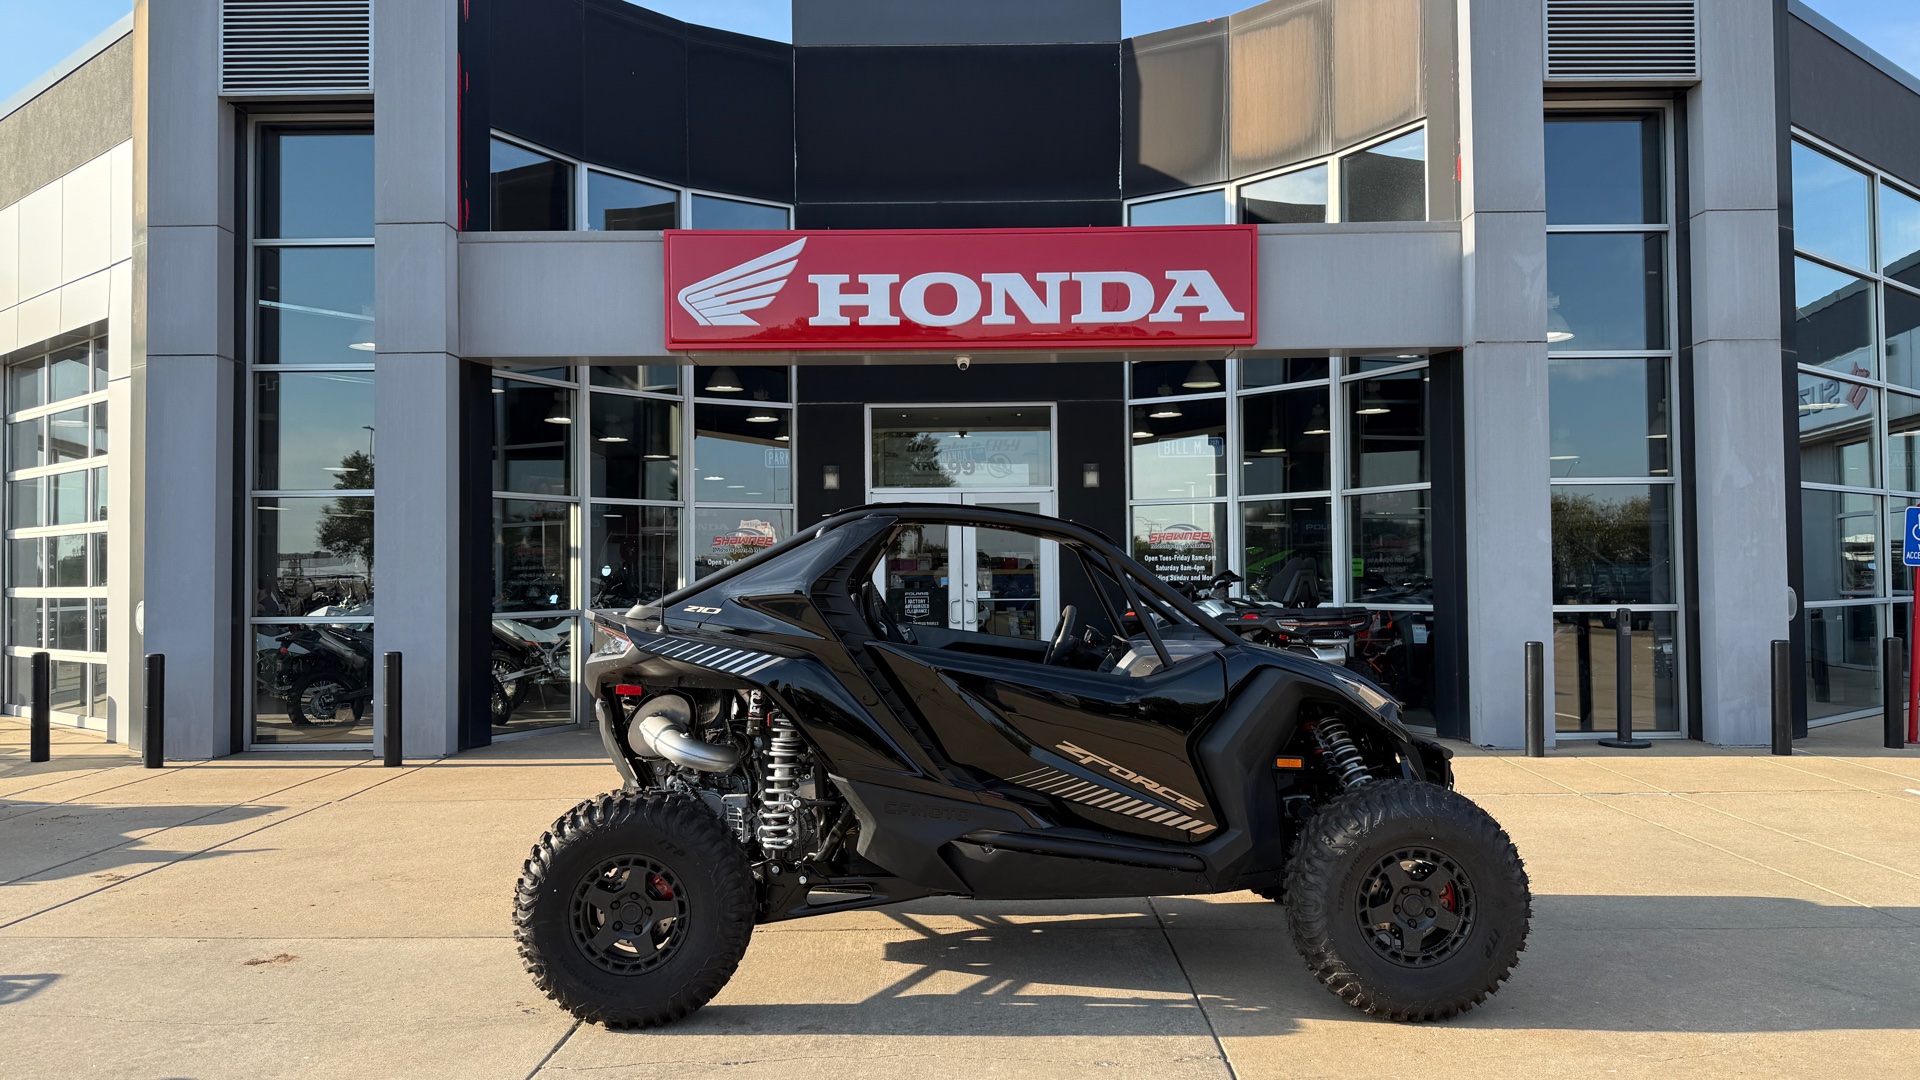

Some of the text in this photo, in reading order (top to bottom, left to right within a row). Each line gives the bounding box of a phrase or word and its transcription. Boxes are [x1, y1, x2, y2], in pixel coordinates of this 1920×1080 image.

[808, 269, 1245, 326] HONDA
[1164, 441, 1188, 455] BILL
[707, 558, 722, 567] Open
[1055, 740, 1205, 811] ZFORCE
[883, 801, 971, 821] CFMOTO
